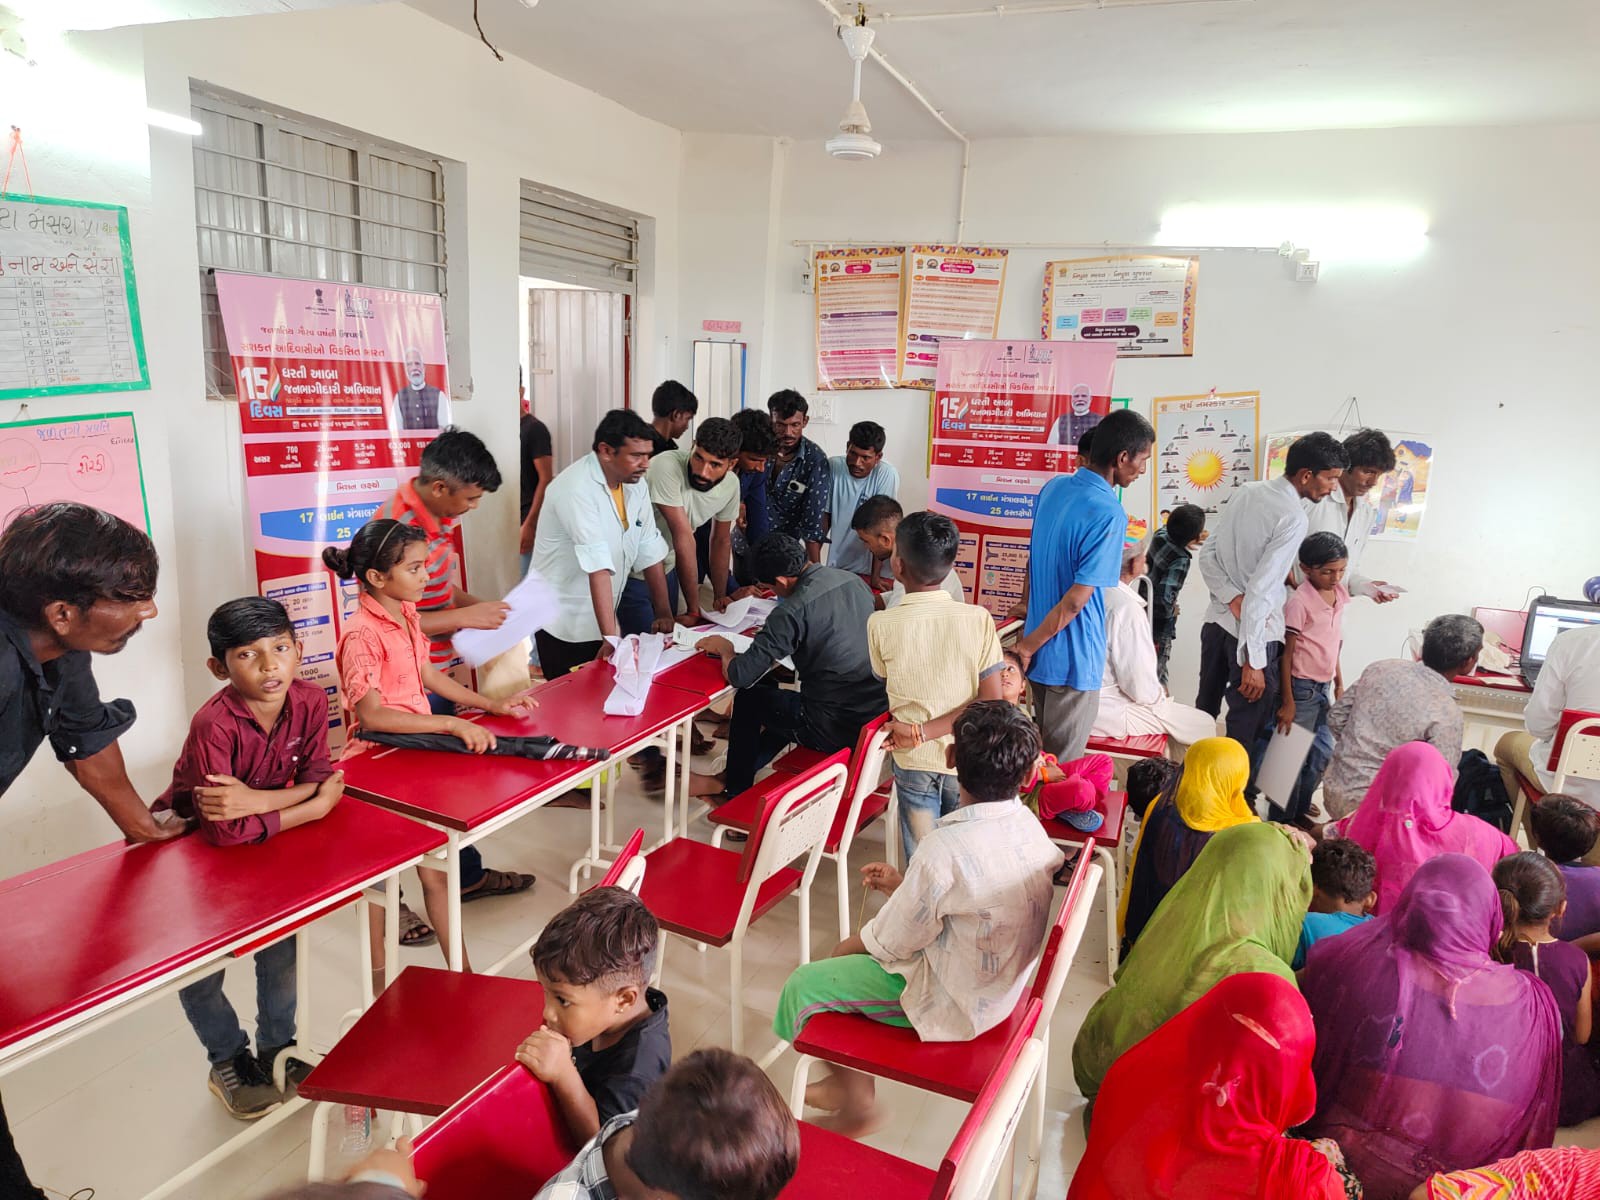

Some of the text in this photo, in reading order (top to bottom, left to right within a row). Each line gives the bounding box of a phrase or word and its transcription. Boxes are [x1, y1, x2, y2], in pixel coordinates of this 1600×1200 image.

[8, 255, 46, 276] નામ
[275, 342, 325, 354] આદિવાસીઓ
[329, 344, 360, 356] વિકસિત
[282, 364, 338, 380] ધરતી આબા
[240, 366, 269, 400] 15
[284, 381, 382, 395] જનભાગીદારી અભિયાન
[940, 397, 960, 419] 15
[970, 397, 1013, 407] ધરતી આબા
[249, 399, 283, 418] દિવસ
[970, 407, 1047, 418] જનભાગીદારી અભિયાન
[941, 419, 966, 430] દિવસ
[286, 446, 299, 454] 700
[966, 493, 978, 501] 17
[299, 512, 314, 523] 17
[336, 527, 352, 539] 25
[300, 668, 318, 676] 1000
